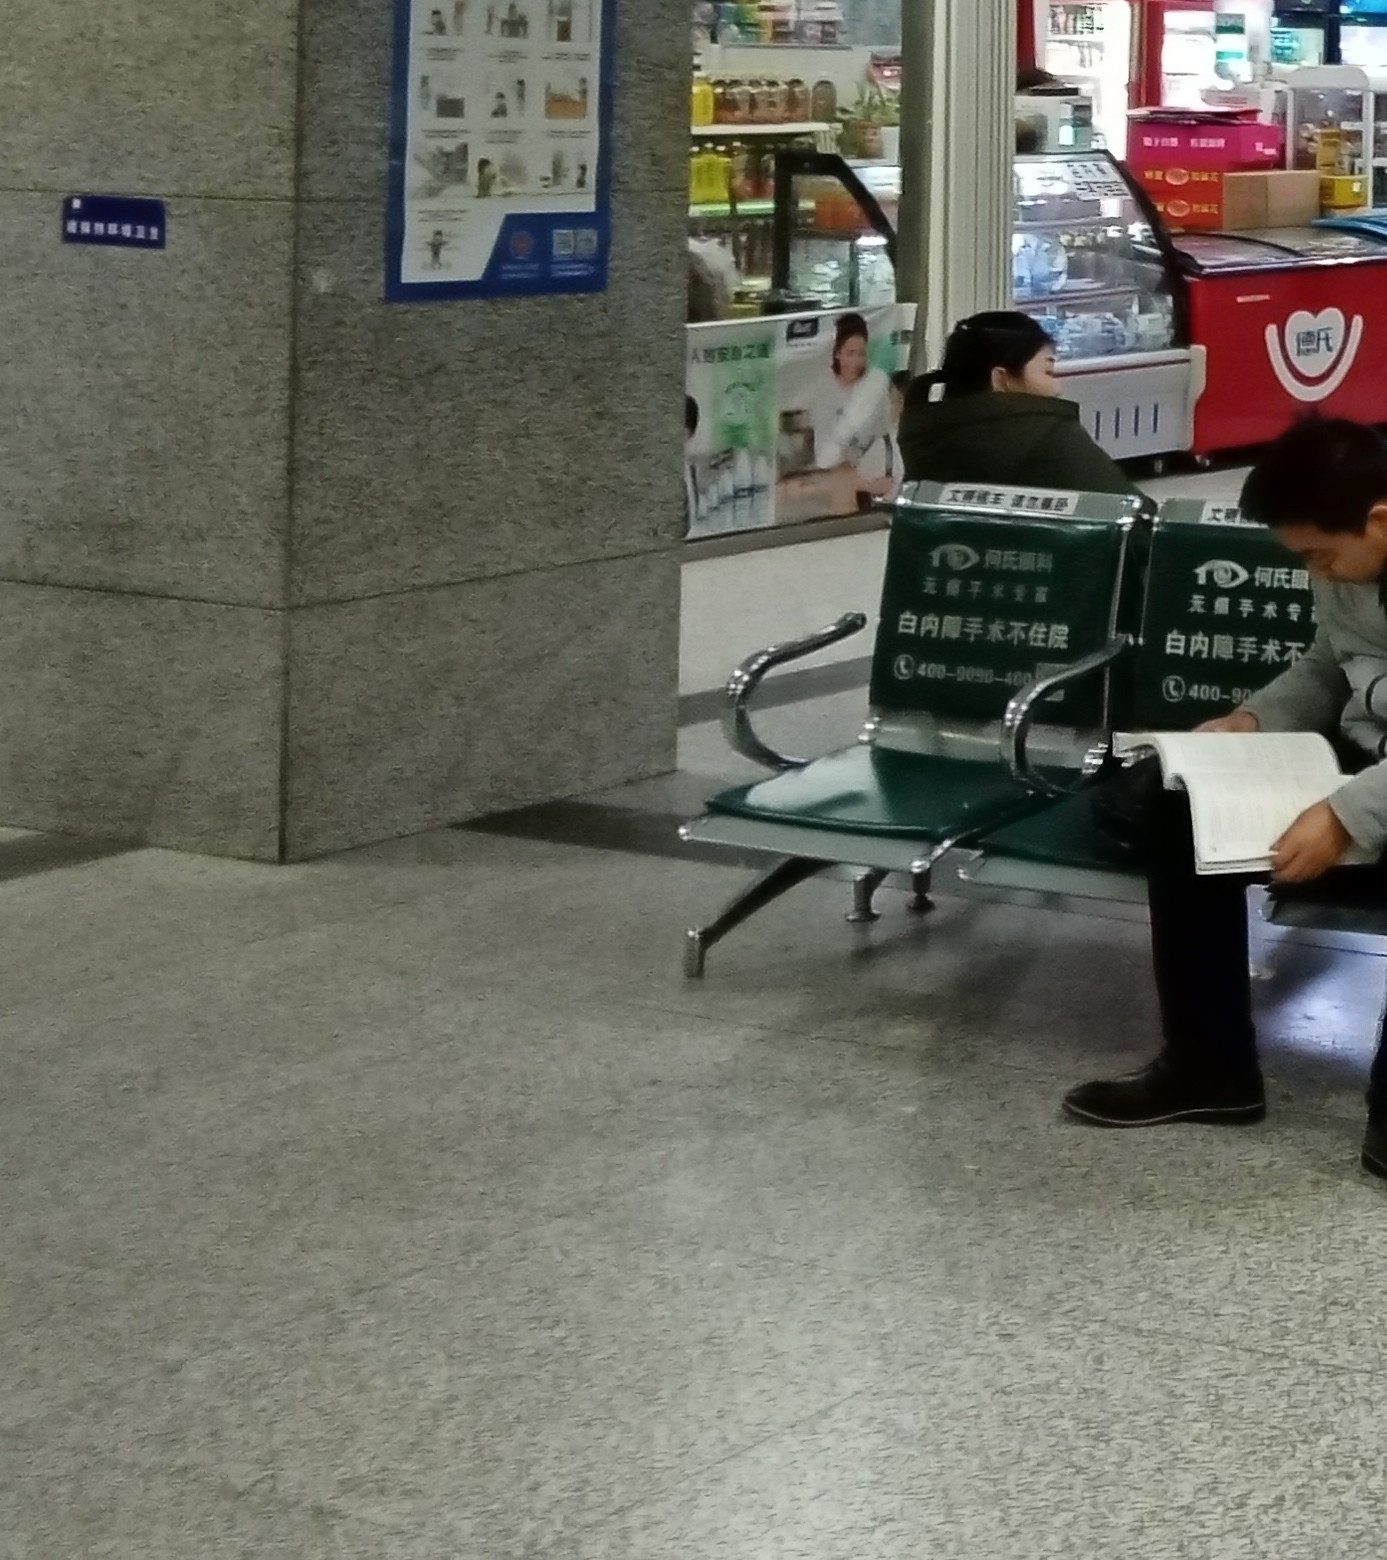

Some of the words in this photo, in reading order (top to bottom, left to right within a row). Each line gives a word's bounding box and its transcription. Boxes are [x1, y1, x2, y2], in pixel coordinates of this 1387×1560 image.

[898, 610, 1070, 649] 白内障手术不住院
